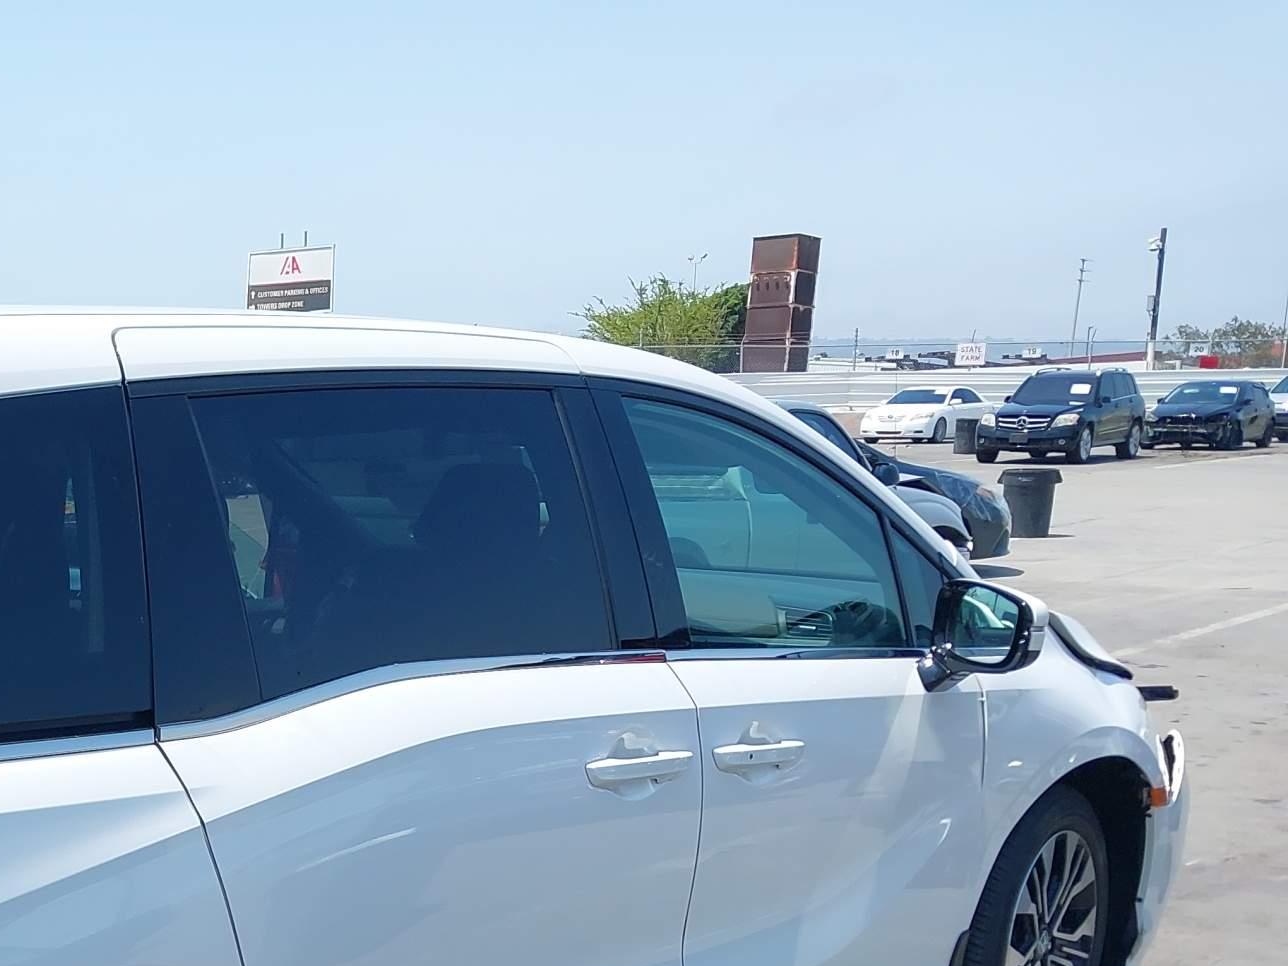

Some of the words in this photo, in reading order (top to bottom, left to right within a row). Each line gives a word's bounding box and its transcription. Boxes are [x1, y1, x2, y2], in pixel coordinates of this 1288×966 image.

[257, 289, 284, 298] CUSTOMER
[284, 288, 305, 297] PARKING
[309, 286, 328, 294] OFFICES
[291, 300, 304, 308] ZONE
[960, 345, 983, 354] STATE
[1027, 347, 1037, 355] 19
[1194, 345, 1204, 353] 20
[960, 354, 982, 362] FARM
